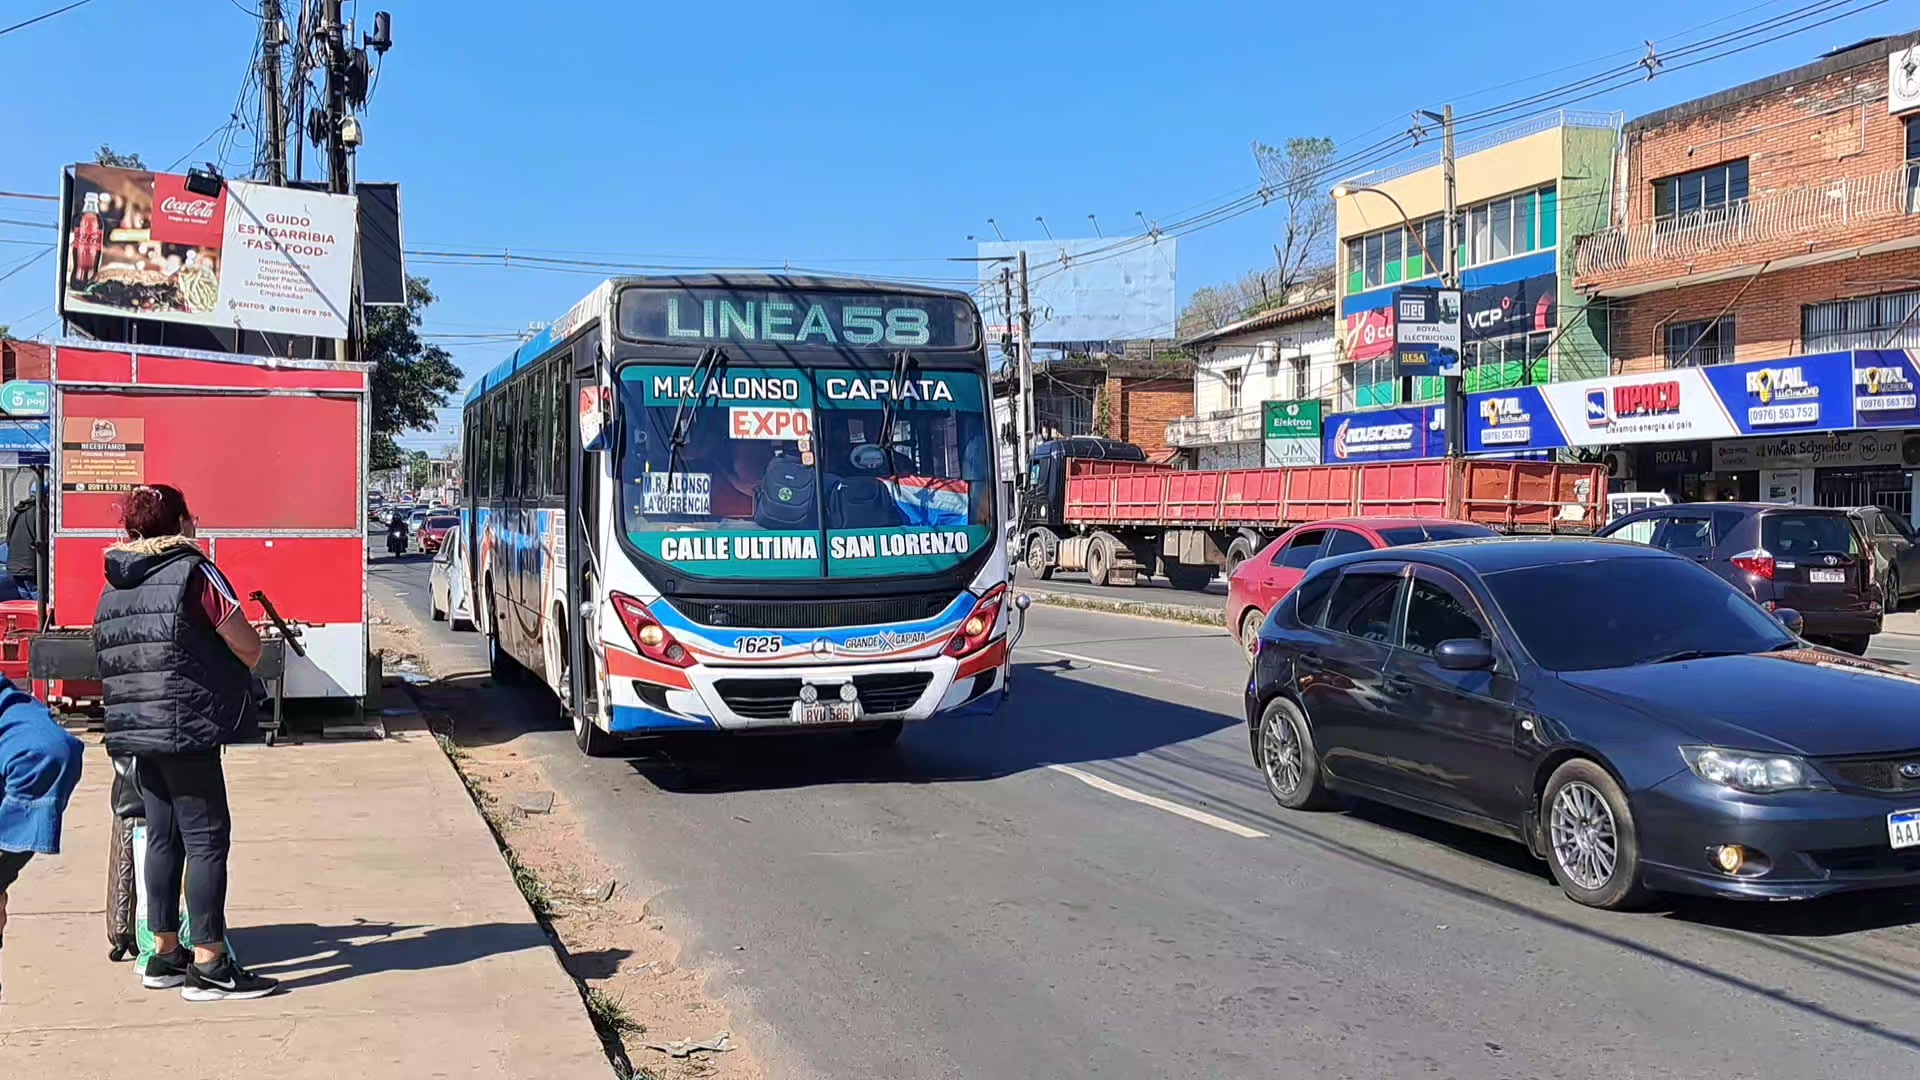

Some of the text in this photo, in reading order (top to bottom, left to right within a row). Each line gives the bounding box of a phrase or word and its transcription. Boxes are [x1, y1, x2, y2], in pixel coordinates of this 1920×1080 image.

[265, 213, 310, 227] GUIDO
[238, 223, 336, 244] ESTIGARRIBIA
[284, 243, 328, 257] FOOD-
[259, 290, 304, 301] Empanadas
[667, 298, 930, 346] LINEA 58
[1466, 308, 1503, 330] VCP
[1416, 325, 1441, 333] ROYAL
[1404, 334, 1456, 342] ELECTRICIDAD
[1402, 352, 1426, 363] RESA
[706, 377, 799, 400] ALONSO
[825, 377, 954, 401] CAPIATA
[1861, 399, 1885, 409] (0976)
[1900, 397, 1915, 407] 752
[1750, 406, 1813, 421] (0976) 563 752
[733, 411, 809, 436] EXPO
[1273, 417, 1312, 428] Elektron
[1667, 421, 1675, 429] al
[81, 443, 126, 451] NECESITAMOS
[1283, 444, 1303, 457] JM
[1799, 439, 1854, 455] Schneider
[1269, 456, 1316, 464] ELECTRICIDAD
[1655, 450, 1688, 464] ROYAL
[669, 477, 710, 494] ALONSO
[656, 495, 710, 513] QUERENCIA
[660, 535, 819, 562] CALLE ULTIMA
[830, 531, 970, 559] SAN LORENZO
[734, 635, 782, 653] 1625
[845, 635, 878, 649] GRANDE
[829, 706, 849, 721] 586
